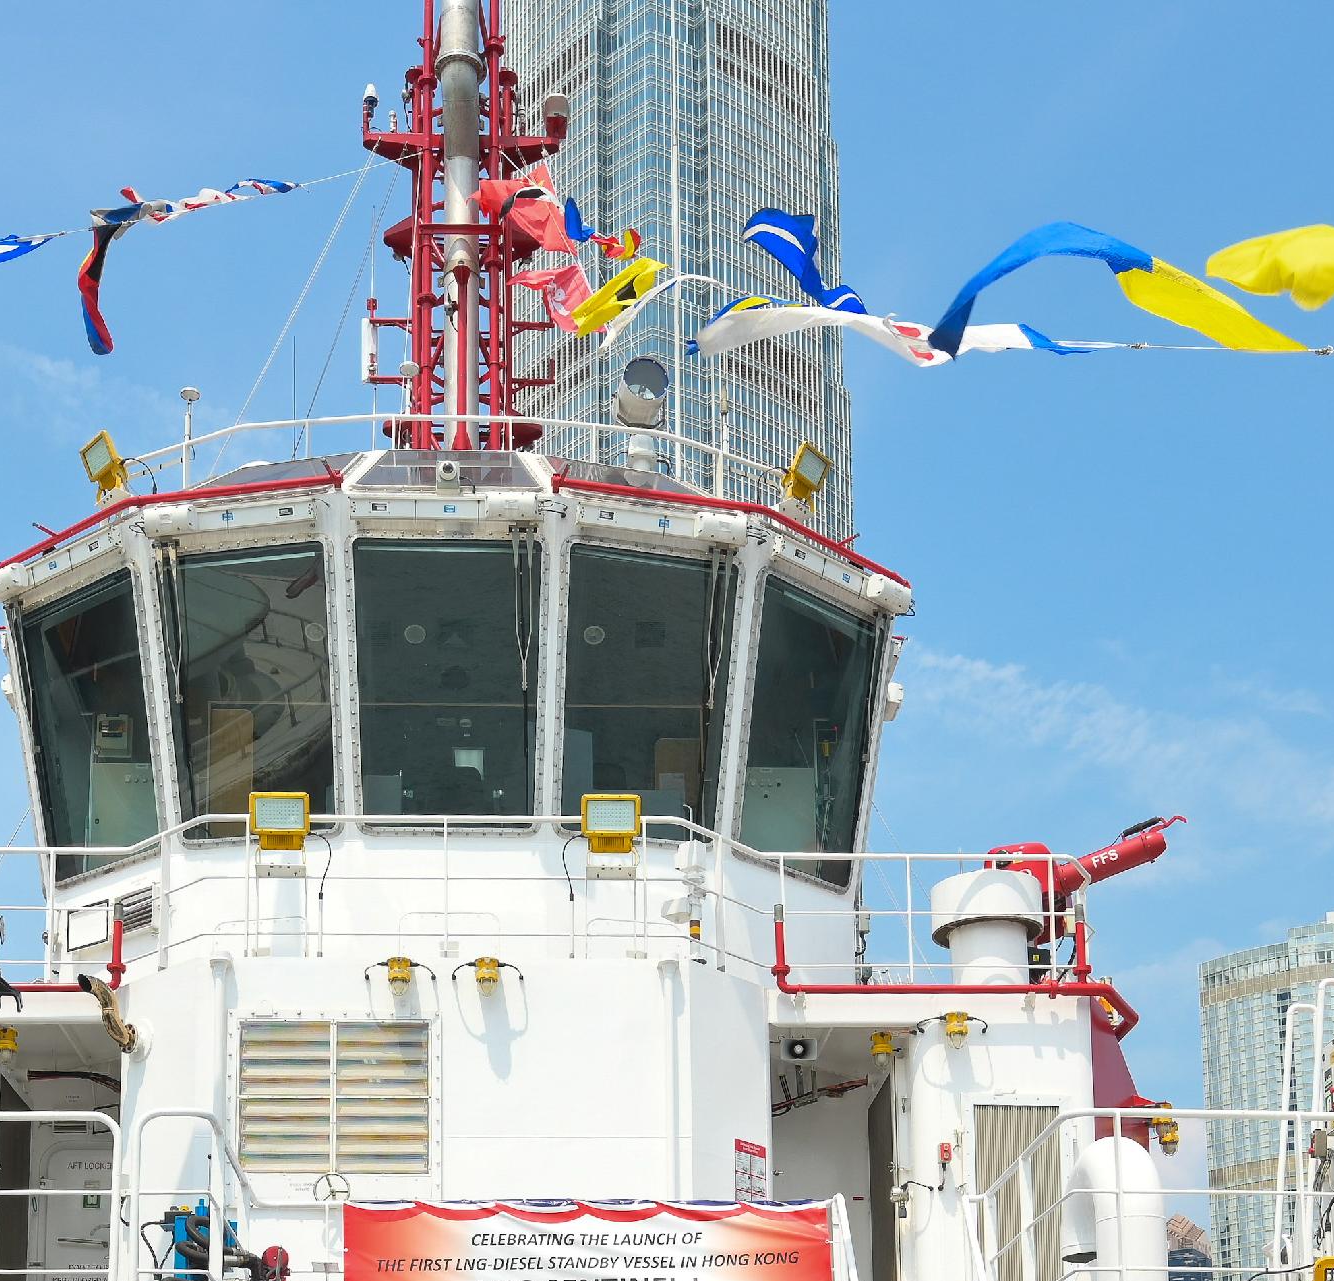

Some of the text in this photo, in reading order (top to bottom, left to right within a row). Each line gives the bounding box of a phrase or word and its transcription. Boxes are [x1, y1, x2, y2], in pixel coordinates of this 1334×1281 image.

[1091, 849, 1119, 869] FFS
[67, 1162, 82, 1170] AFT
[471, 1232, 703, 1247] CELEBRATING THE LAUNCH OF
[376, 1251, 799, 1272] THE FIRST LNG-DIESEL STANDBY VESSEL IN HONG KONG
